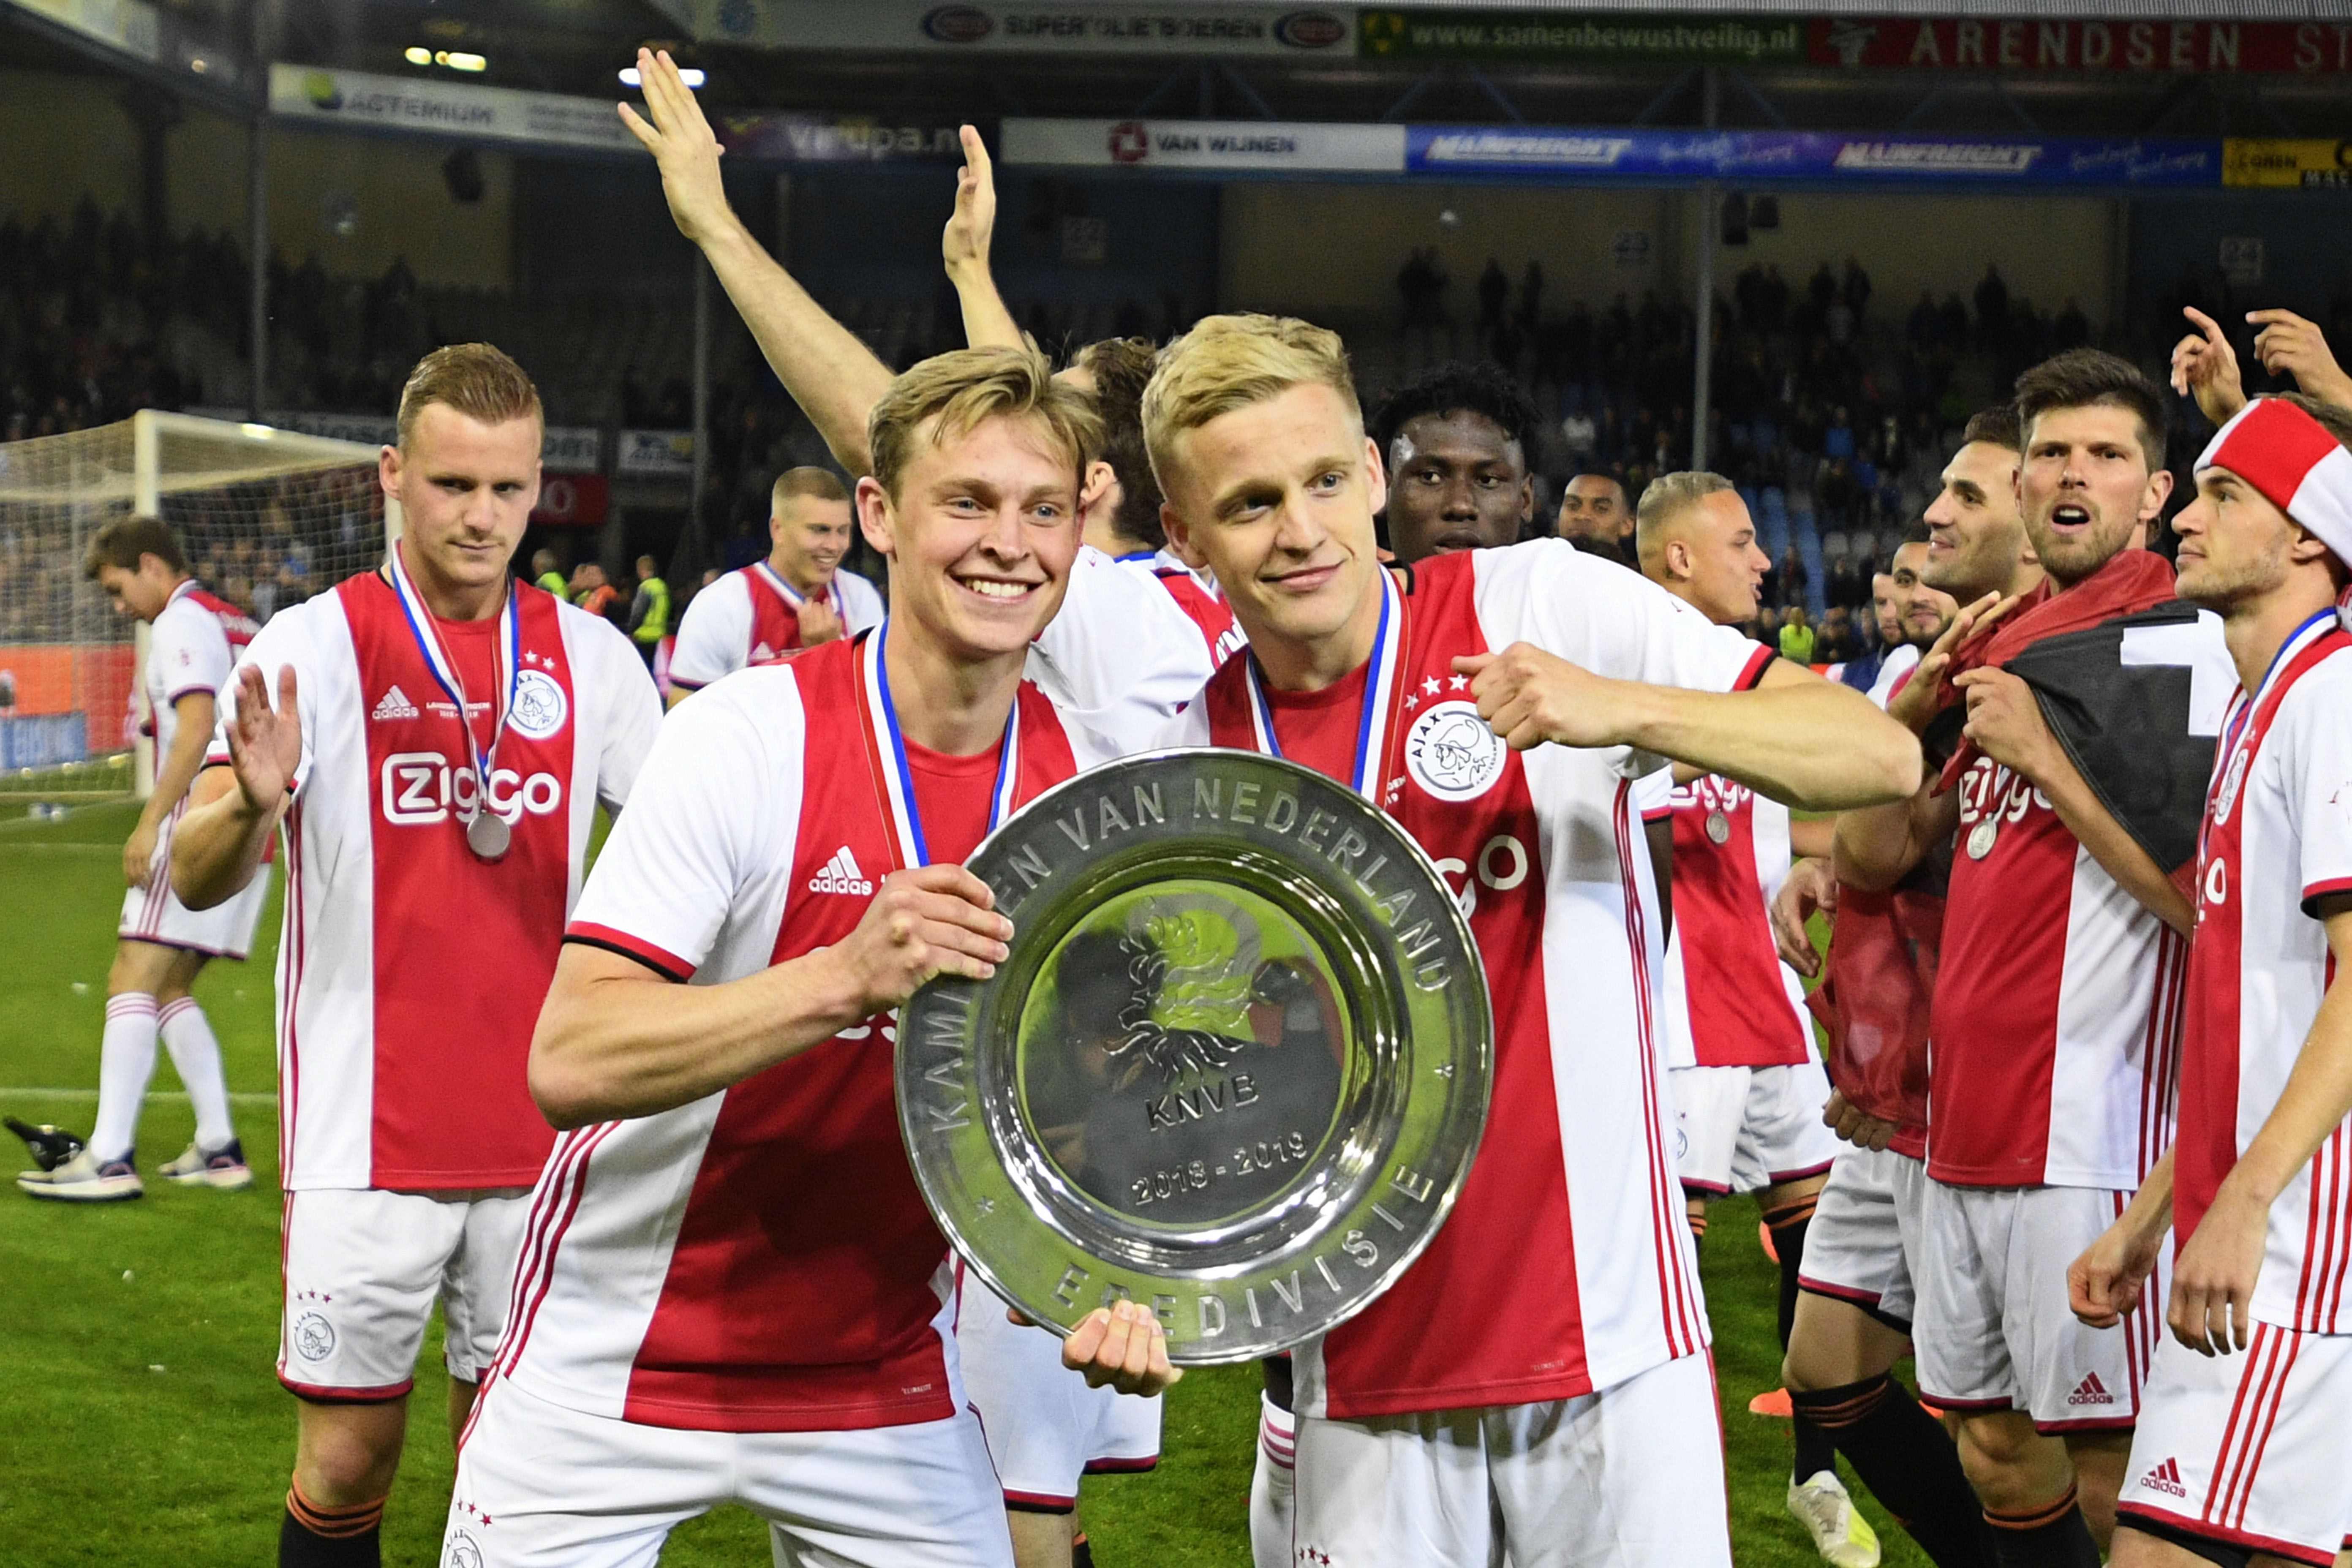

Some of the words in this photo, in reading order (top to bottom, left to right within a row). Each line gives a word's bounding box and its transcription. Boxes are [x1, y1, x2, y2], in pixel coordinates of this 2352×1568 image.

[1910, 22, 2240, 67] ARENDSEN
[1157, 134, 1200, 152] VAN
[372, 707, 419, 719] adidas
[1412, 713, 1441, 758] AJAX
[808, 878, 872, 896] adidas
[1056, 782, 1165, 851] VAN
[1193, 778, 1452, 992] NEDERLAND
[1145, 1070, 1259, 1132] KNVB
[2068, 1395, 2113, 1405] adidas
[2140, 1475, 2186, 1498] adidas
